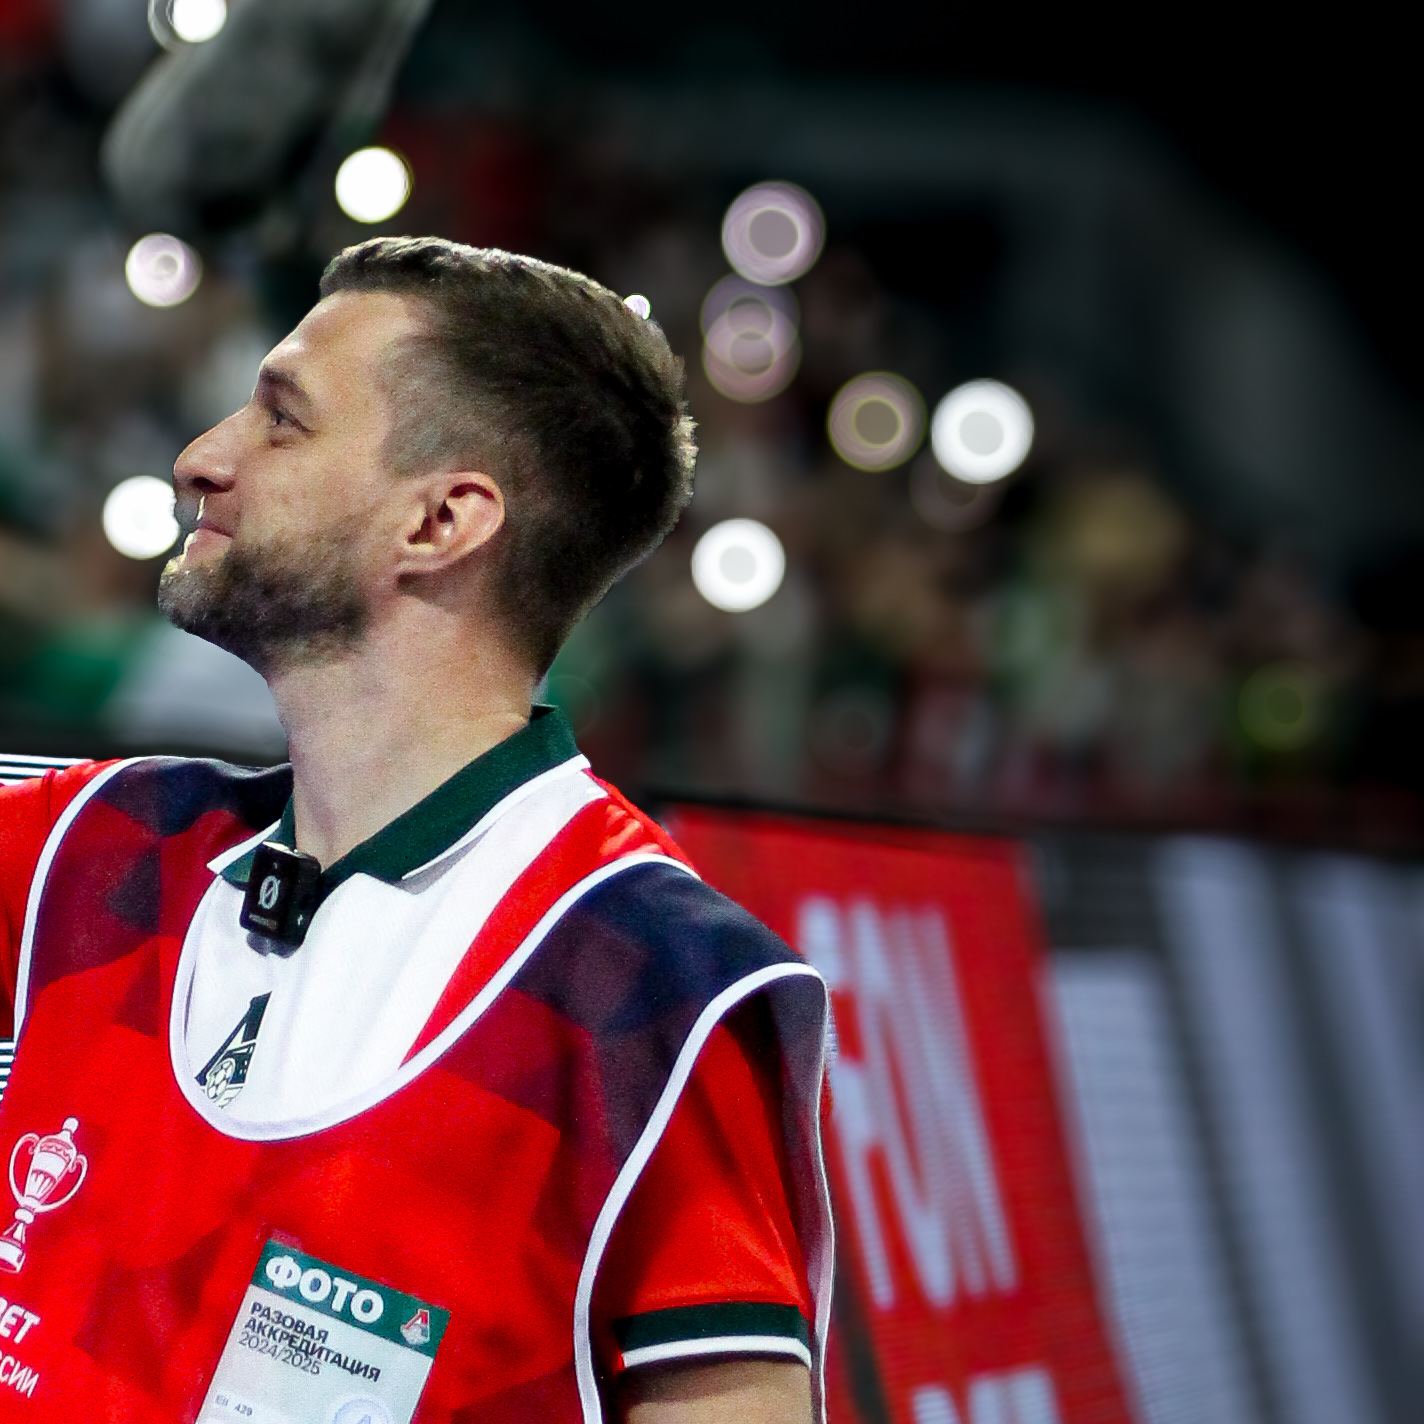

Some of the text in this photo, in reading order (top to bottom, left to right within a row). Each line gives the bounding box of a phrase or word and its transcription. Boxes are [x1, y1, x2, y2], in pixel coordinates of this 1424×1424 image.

[798, 894, 1019, 1311] FON
[265, 1254, 384, 1323] ФОТО
[238, 1332, 321, 1377] 2024/2025
[244, 1317, 382, 1383] АККРЕДИТАЦИЯ
[250, 1301, 329, 1343] РАЗОВАЯ
